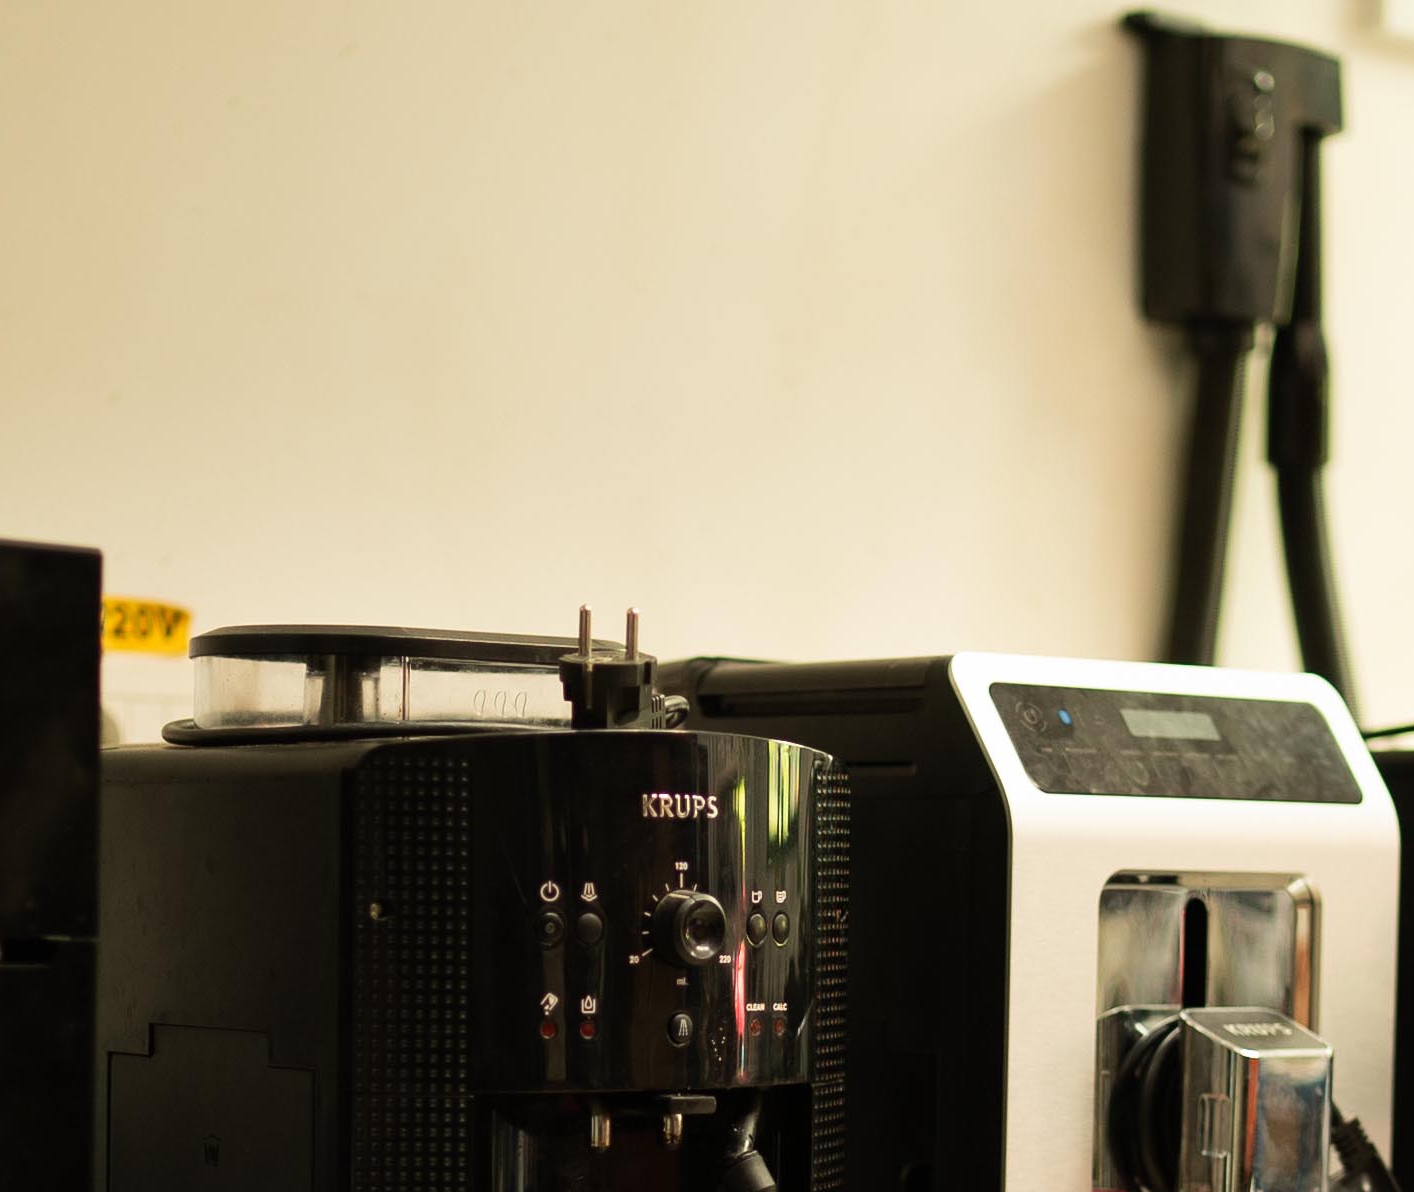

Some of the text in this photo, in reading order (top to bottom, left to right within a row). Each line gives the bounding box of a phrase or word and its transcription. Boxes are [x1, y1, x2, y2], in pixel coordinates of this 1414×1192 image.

[642, 793, 719, 818] KRUPS
[675, 861, 688, 871] 120
[629, 955, 640, 964] 20
[719, 955, 732, 964] 220
[746, 1002, 788, 1011] CLEAN CALC
[1223, 1022, 1293, 1037] KRUPS
